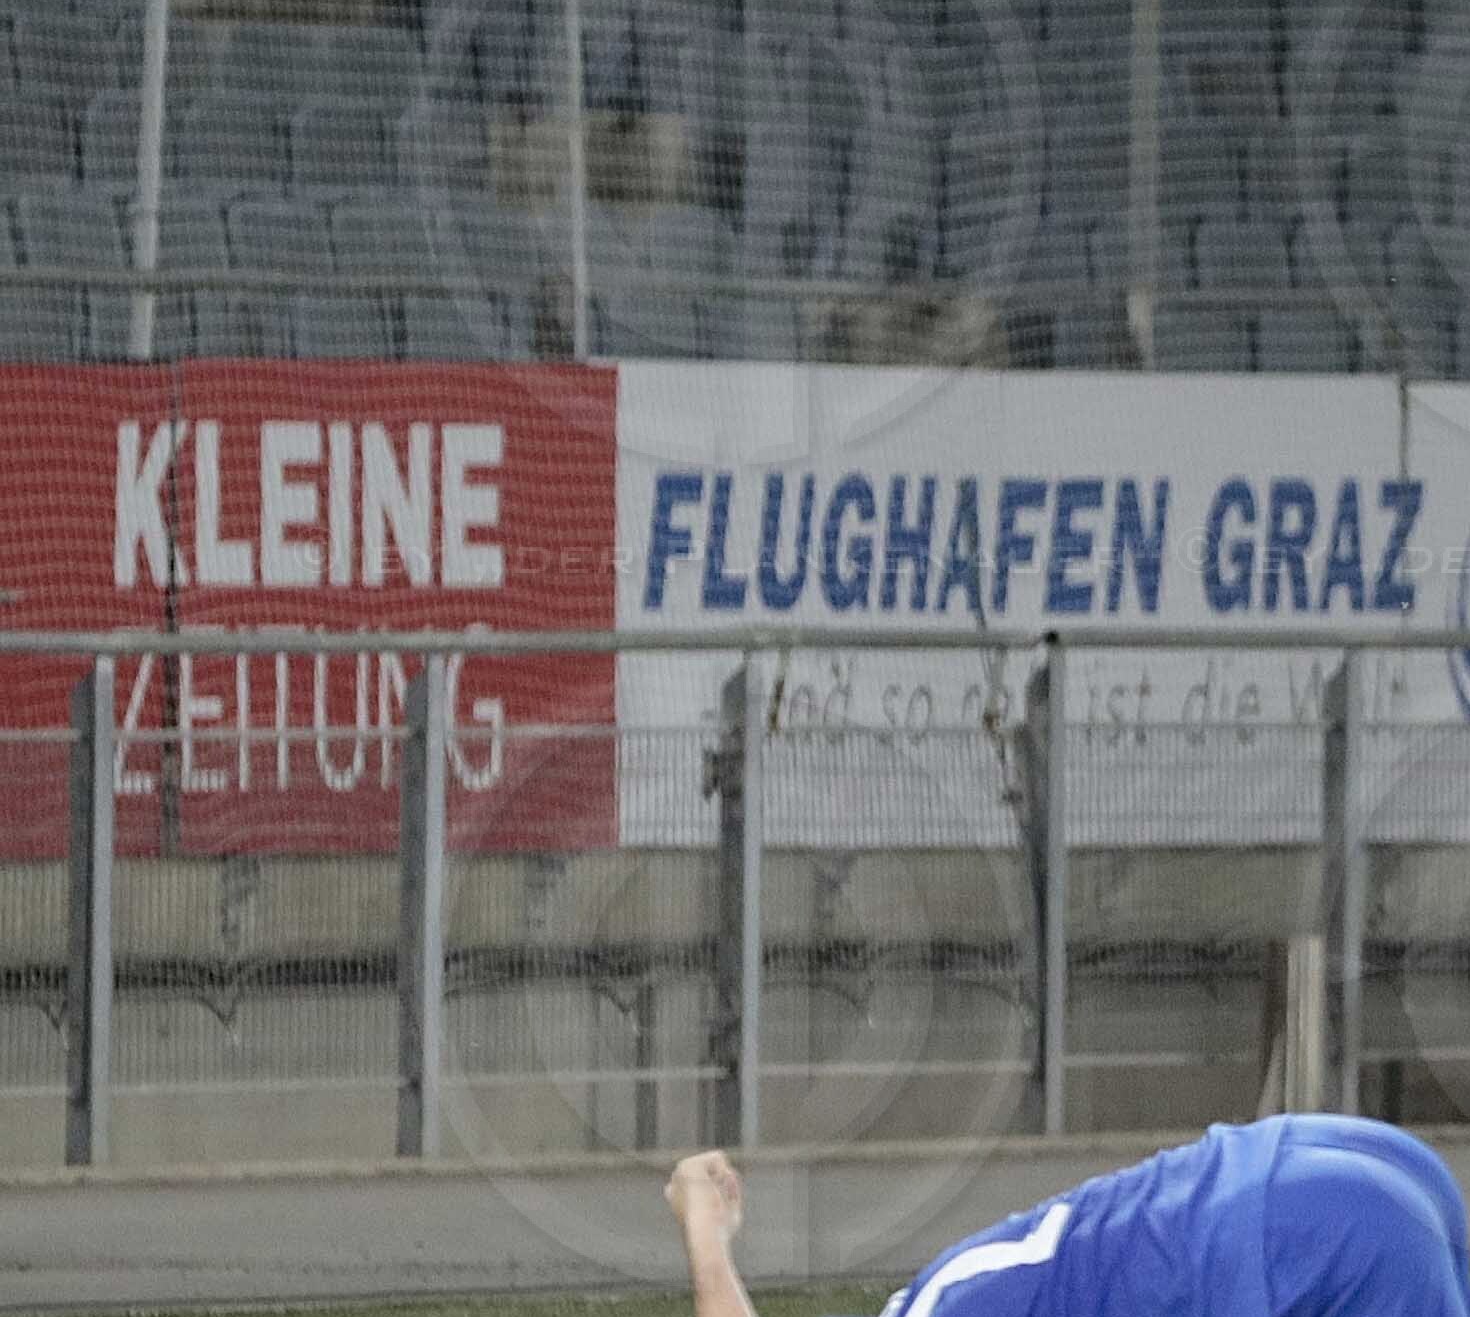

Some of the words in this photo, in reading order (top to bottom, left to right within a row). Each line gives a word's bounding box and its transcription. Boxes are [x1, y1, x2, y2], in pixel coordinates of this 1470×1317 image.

[112, 419, 505, 589] KLEINE
[643, 469, 1170, 613] FLUGHAFEN
[1203, 474, 1426, 613] GRAZ
